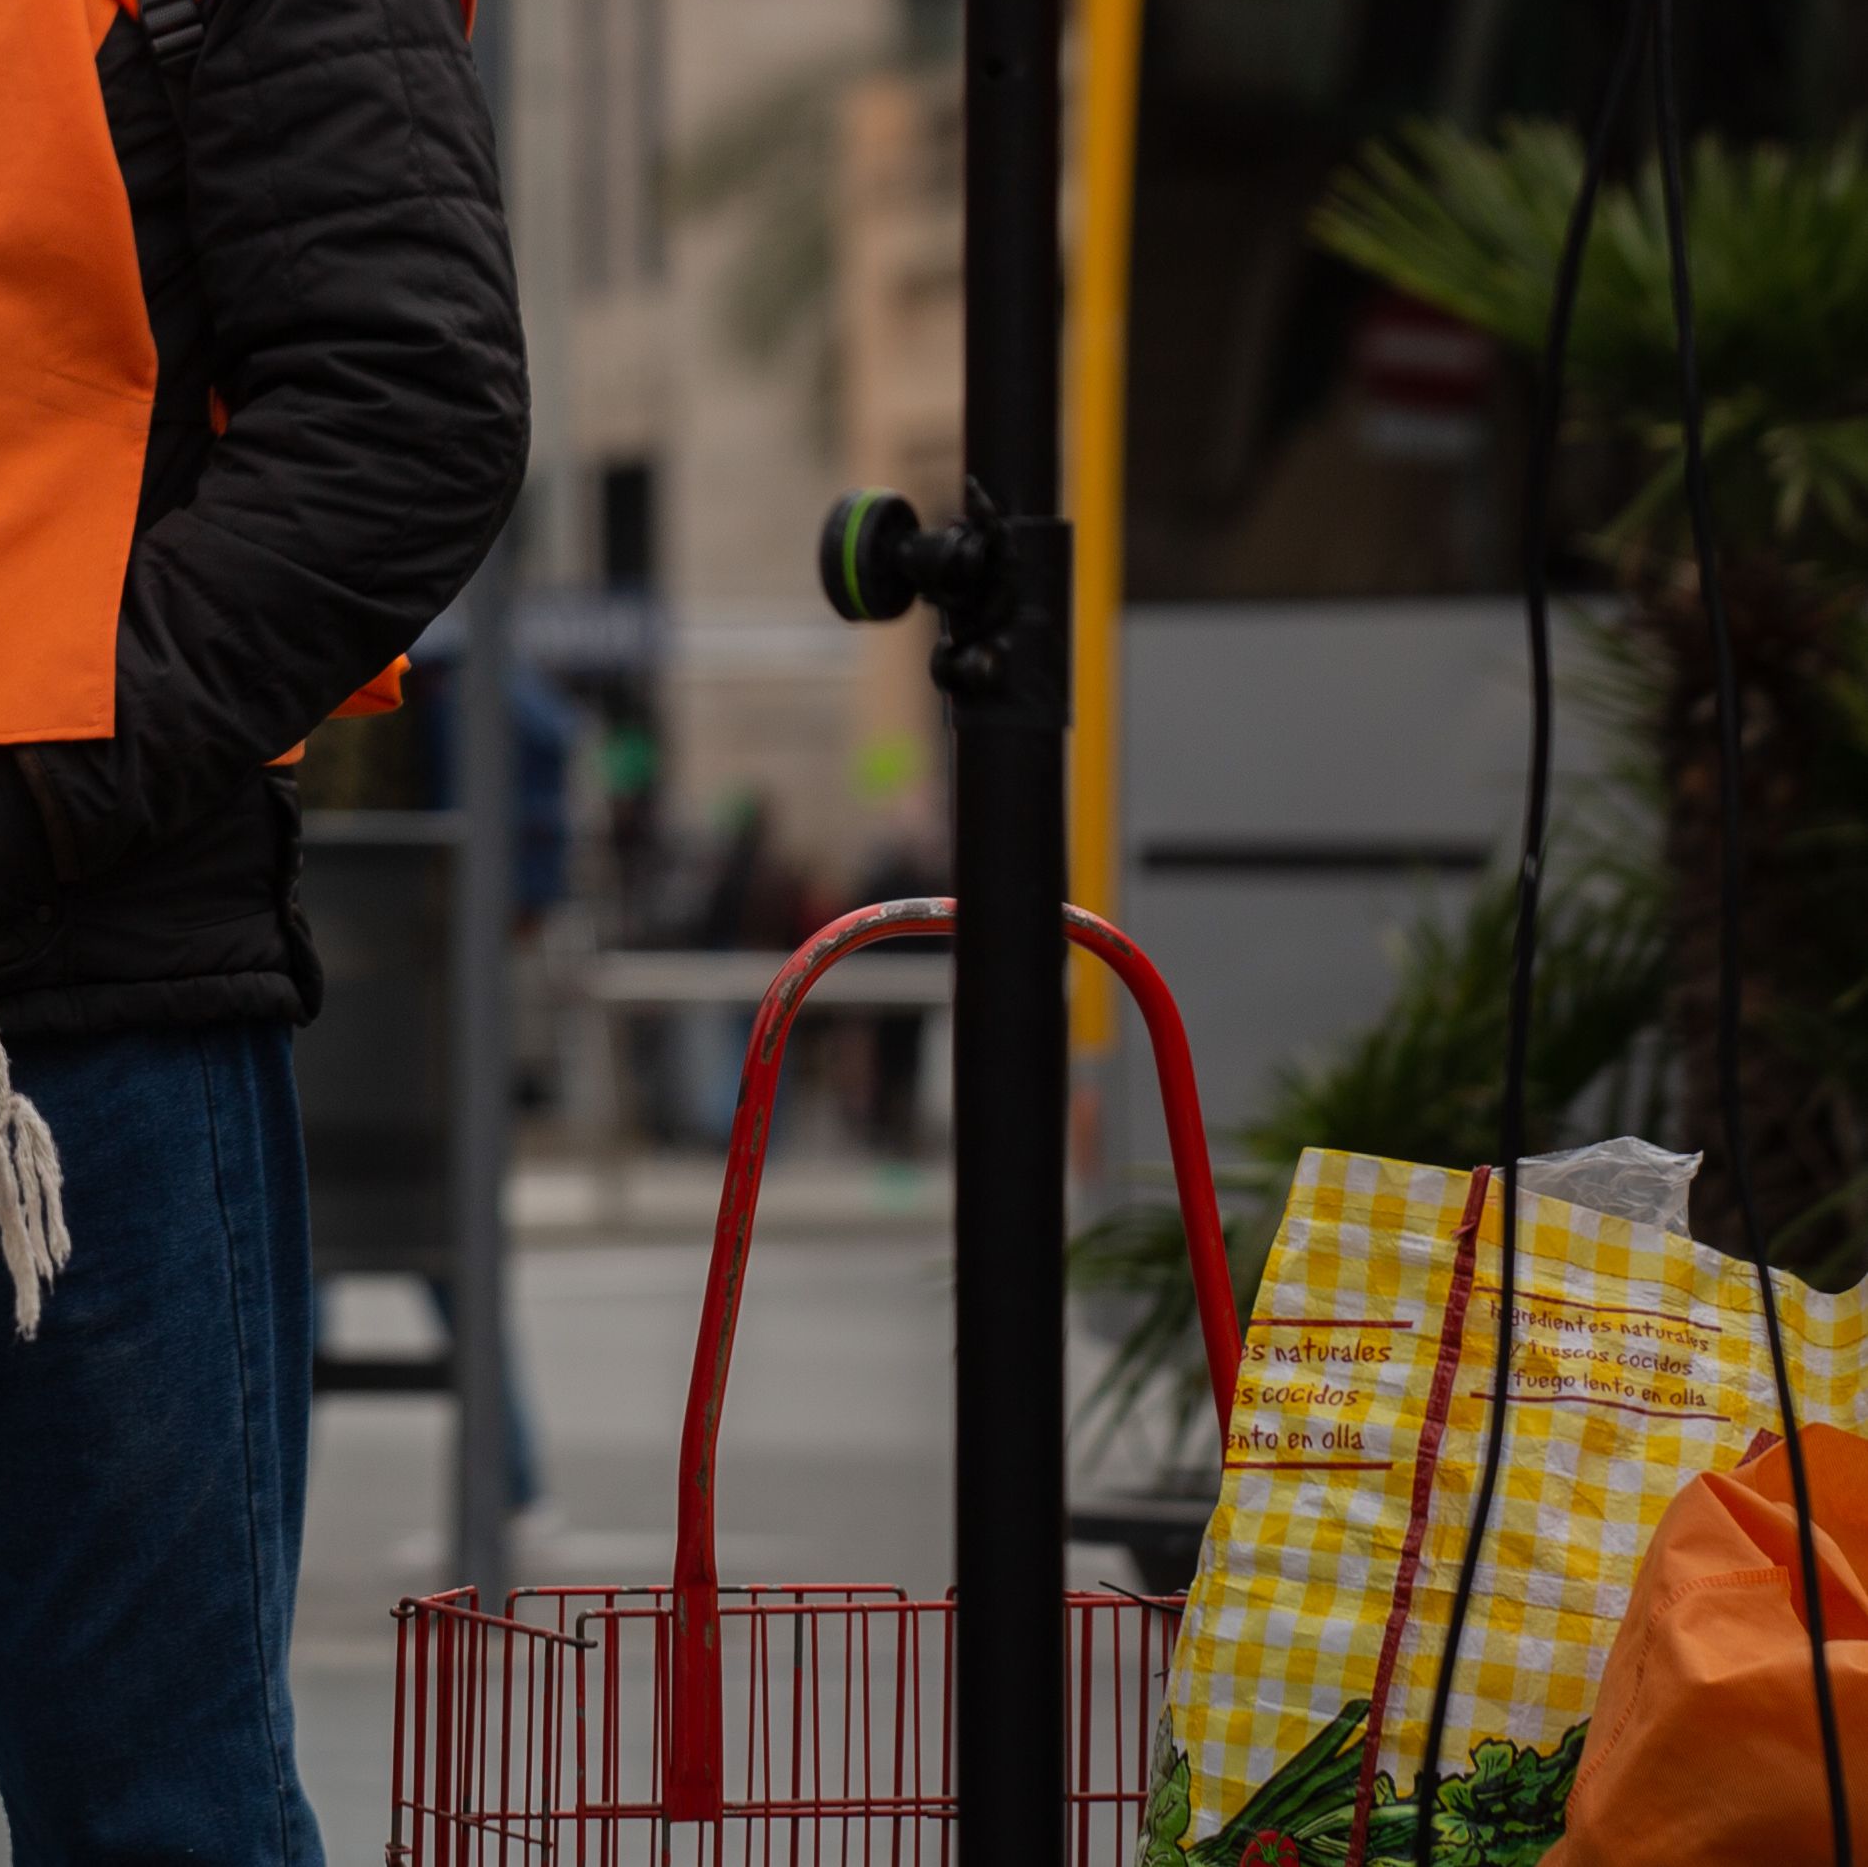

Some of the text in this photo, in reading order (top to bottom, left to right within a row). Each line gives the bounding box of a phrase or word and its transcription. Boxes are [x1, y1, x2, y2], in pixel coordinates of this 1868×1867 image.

[1620, 1321, 1709, 1352] naturales
[1275, 1337, 1393, 1363] naturales
[1617, 1352, 1693, 1376] cocidos
[1261, 1383, 1360, 1406] cocidos
[1513, 1368, 1707, 1407] fuego lento en olla
[1288, 1432, 1313, 1450] en
[1322, 1424, 1365, 1450] olla
